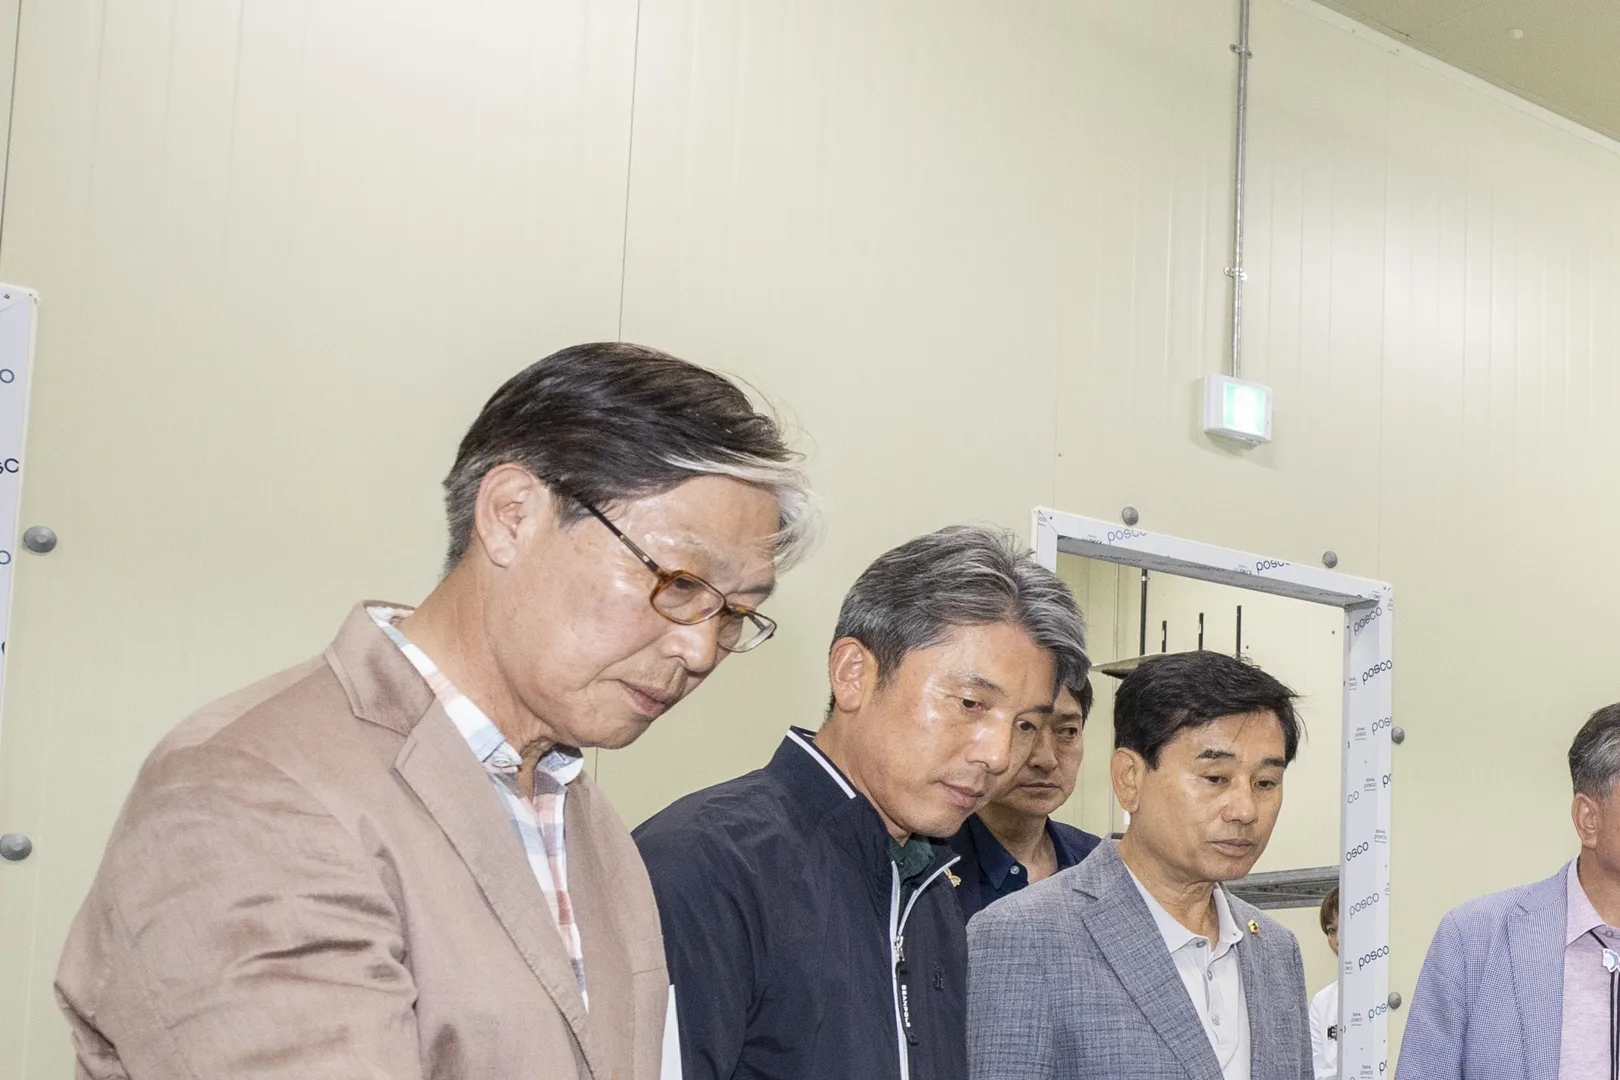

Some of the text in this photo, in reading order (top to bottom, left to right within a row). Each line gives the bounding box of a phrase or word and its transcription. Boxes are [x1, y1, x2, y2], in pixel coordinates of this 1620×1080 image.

[1353, 606, 1383, 635] posco
[1362, 659, 1392, 685] posco
[1349, 892, 1379, 919] posco
[1358, 945, 1389, 970] posco
[901, 984, 911, 1028] BEANPOLE
